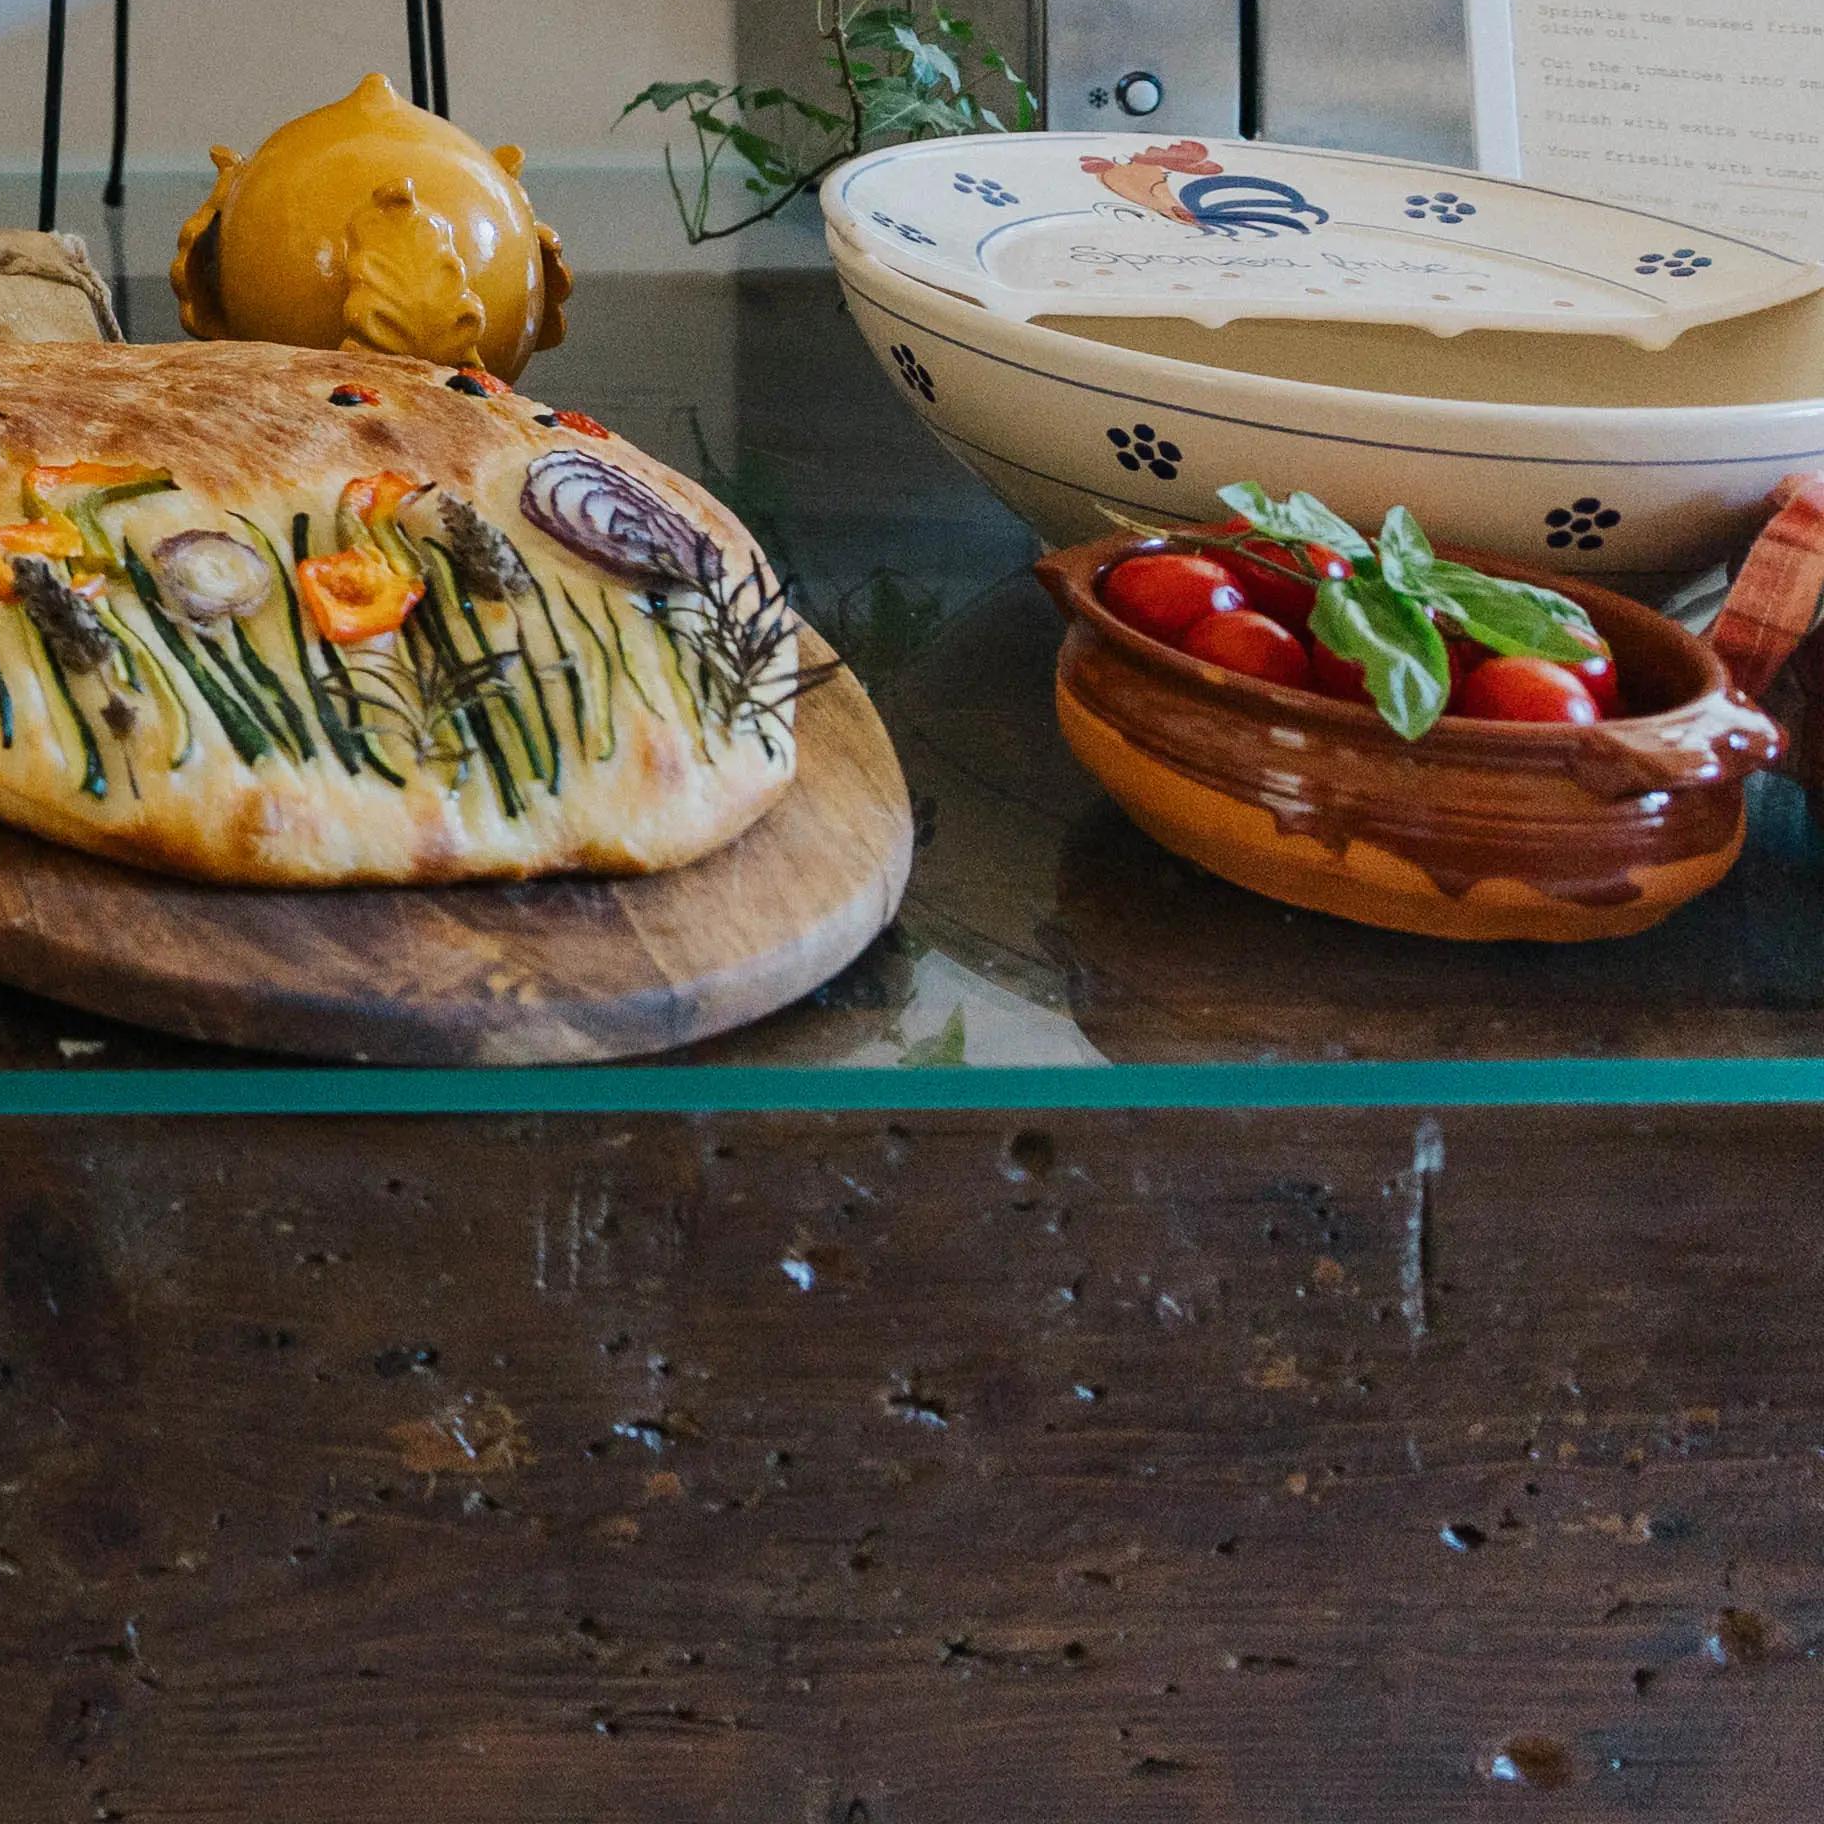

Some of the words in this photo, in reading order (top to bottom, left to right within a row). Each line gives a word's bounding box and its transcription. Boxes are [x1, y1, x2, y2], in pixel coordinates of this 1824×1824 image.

[1537, 4, 1627, 21] Sprinkle
[1639, 11, 1672, 26] the
[1686, 15, 1753, 32] soaked
[1540, 24, 1594, 38] olive
[1605, 27, 1648, 41] oil.
[1541, 57, 1574, 70] Cut
[1589, 60, 1621, 73] the
[1636, 65, 1724, 83] tomatoes
[1740, 75, 1785, 88] into
[1544, 75, 1641, 93] friselle;
[1546, 110, 1612, 126] Finish
[1624, 117, 1669, 131] with
[1680, 124, 1737, 137] extra
[1749, 129, 1820, 145] virgin
[1548, 145, 1592, 160] Your
[1605, 150, 1695, 169] friselle
[1706, 160, 1753, 176] with
